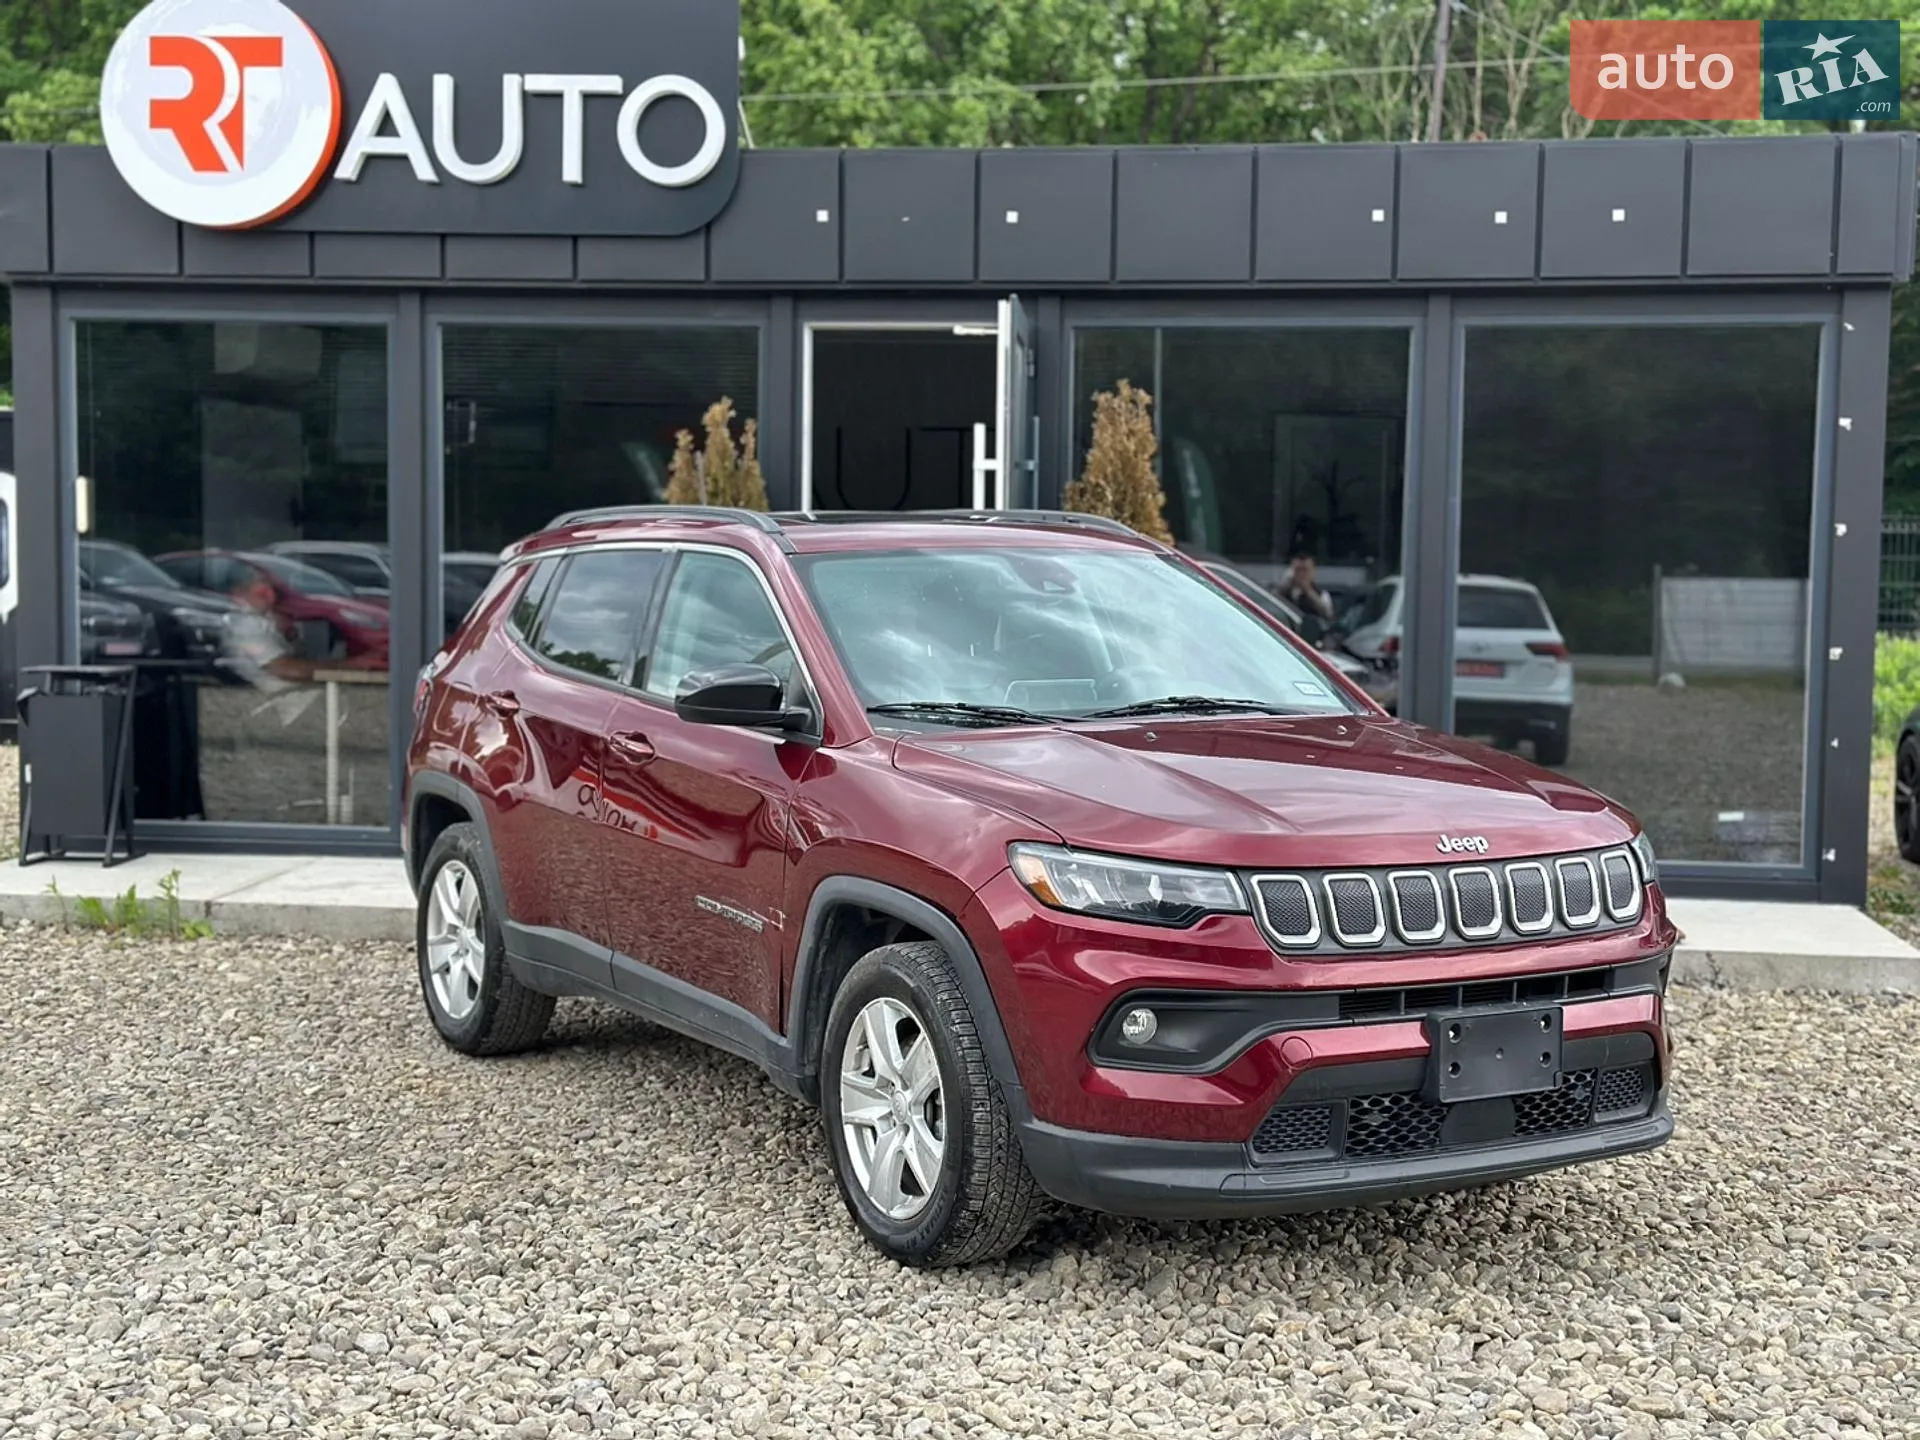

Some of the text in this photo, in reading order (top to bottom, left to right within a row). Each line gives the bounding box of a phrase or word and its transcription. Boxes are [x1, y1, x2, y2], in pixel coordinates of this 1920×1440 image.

[149, 36, 727, 186] RT AUTO
[1436, 834, 1489, 854] Jeep
